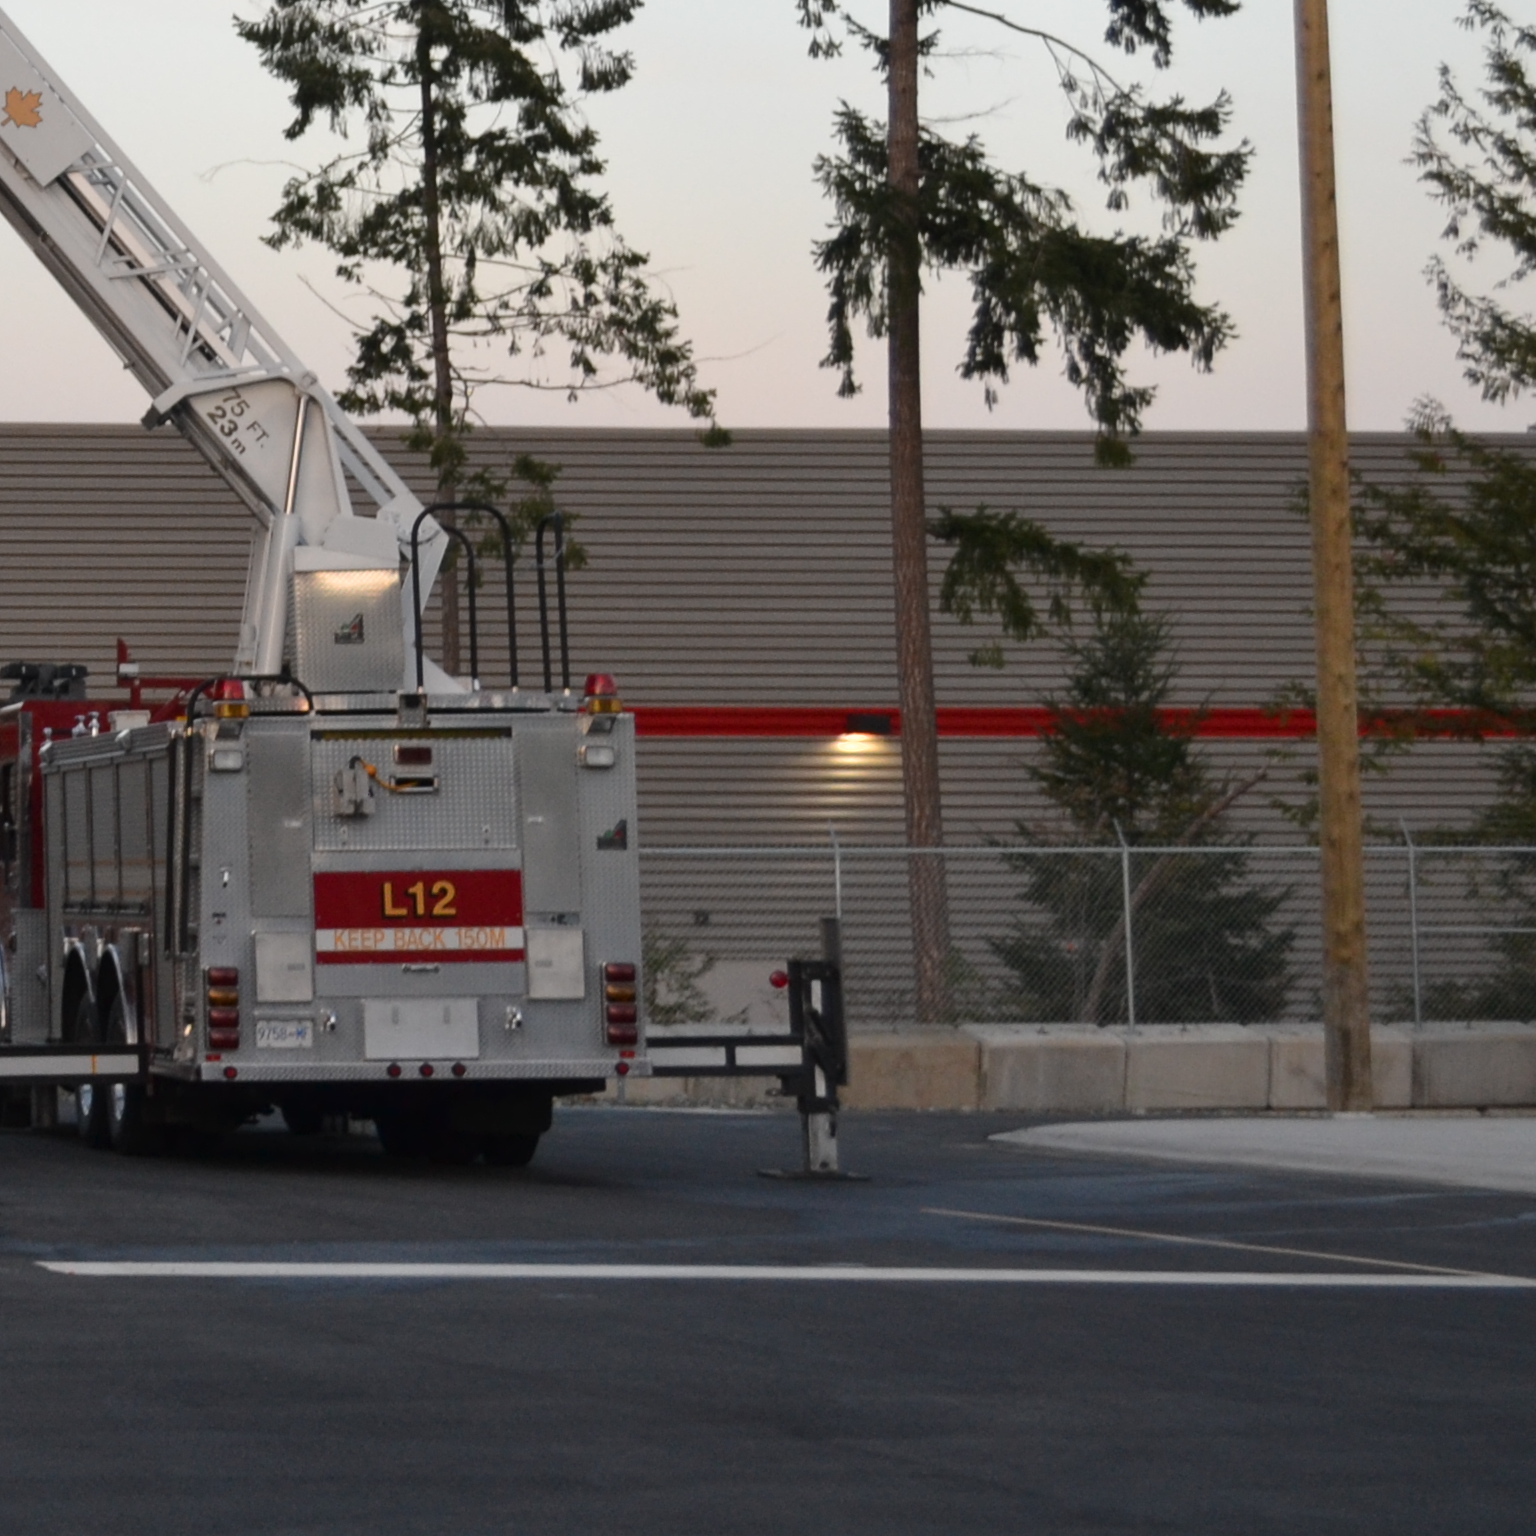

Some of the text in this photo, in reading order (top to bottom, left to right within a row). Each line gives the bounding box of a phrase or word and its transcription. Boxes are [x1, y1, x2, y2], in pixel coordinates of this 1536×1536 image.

[222, 387, 250, 417] 75
[207, 405, 247, 455] 23 m
[381, 880, 456, 918] L12
[334, 927, 506, 951] KEEP BACK 150M
